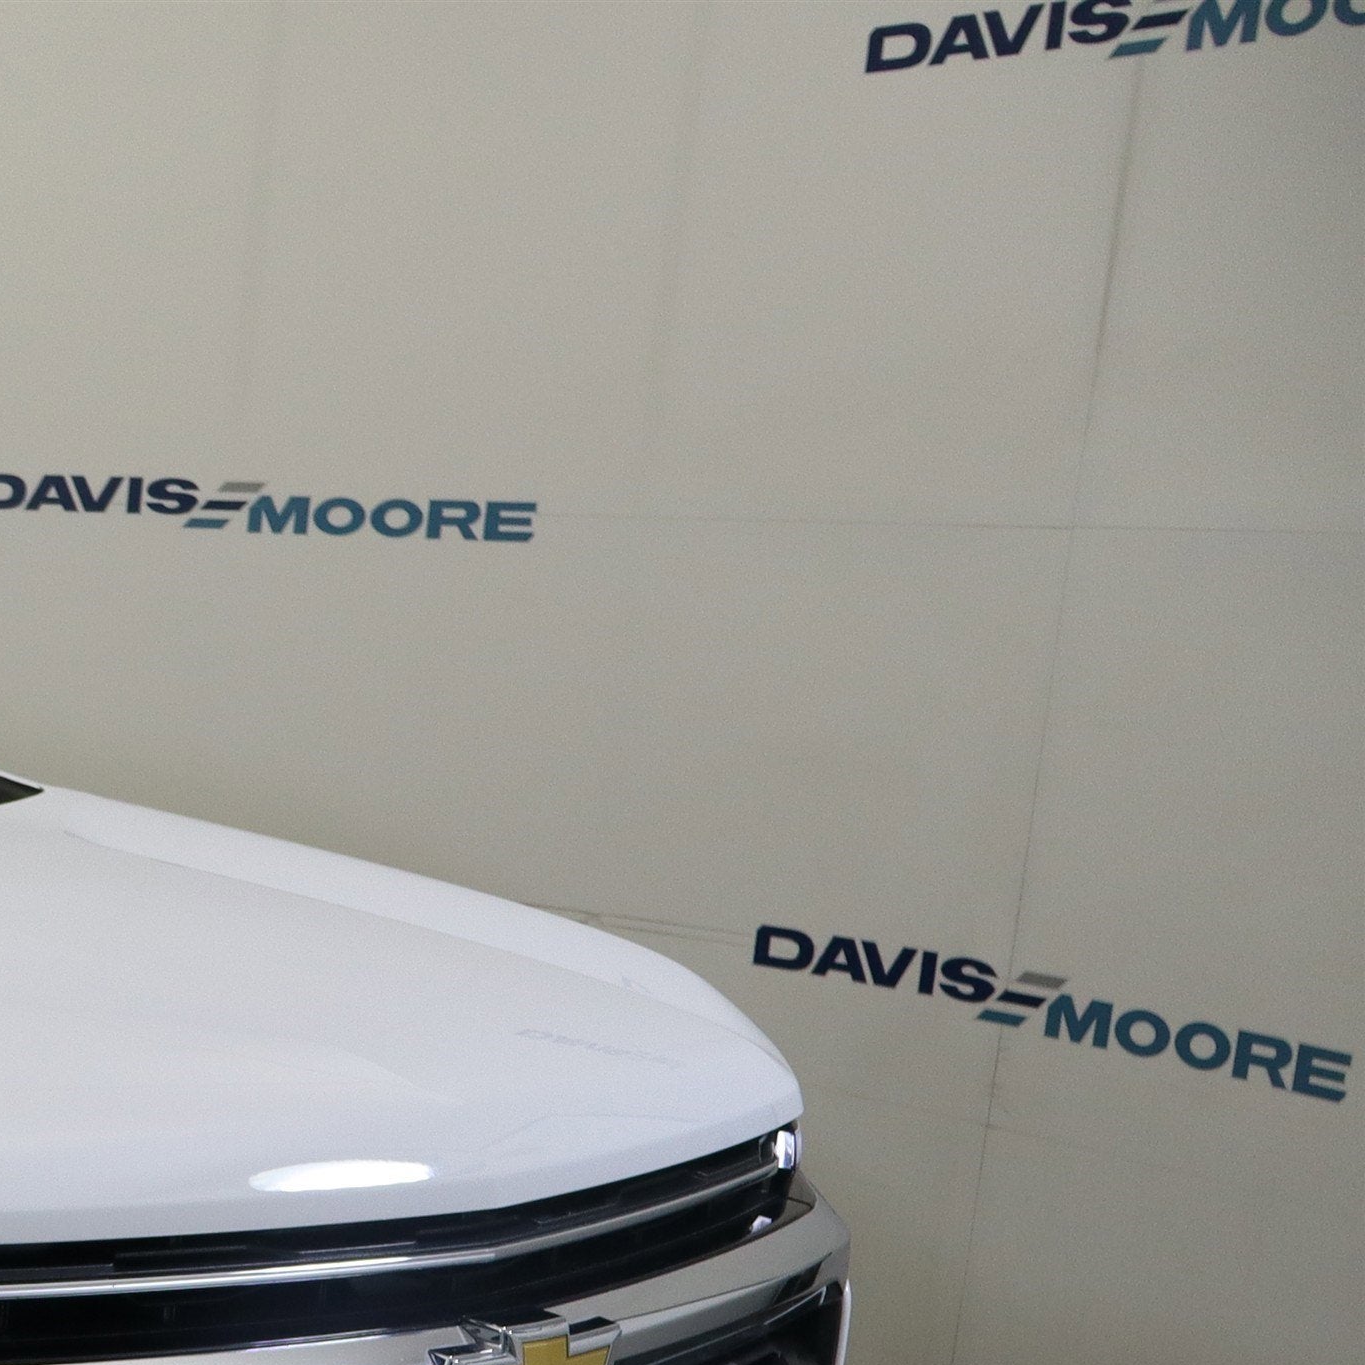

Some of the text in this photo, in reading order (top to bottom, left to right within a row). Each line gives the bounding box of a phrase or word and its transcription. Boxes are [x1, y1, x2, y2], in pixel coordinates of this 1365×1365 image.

[865, 0, 1131, 74] DAVIS
[246, 495, 538, 542] MOORE
[752, 924, 1354, 1103] DAVIS MOORE
